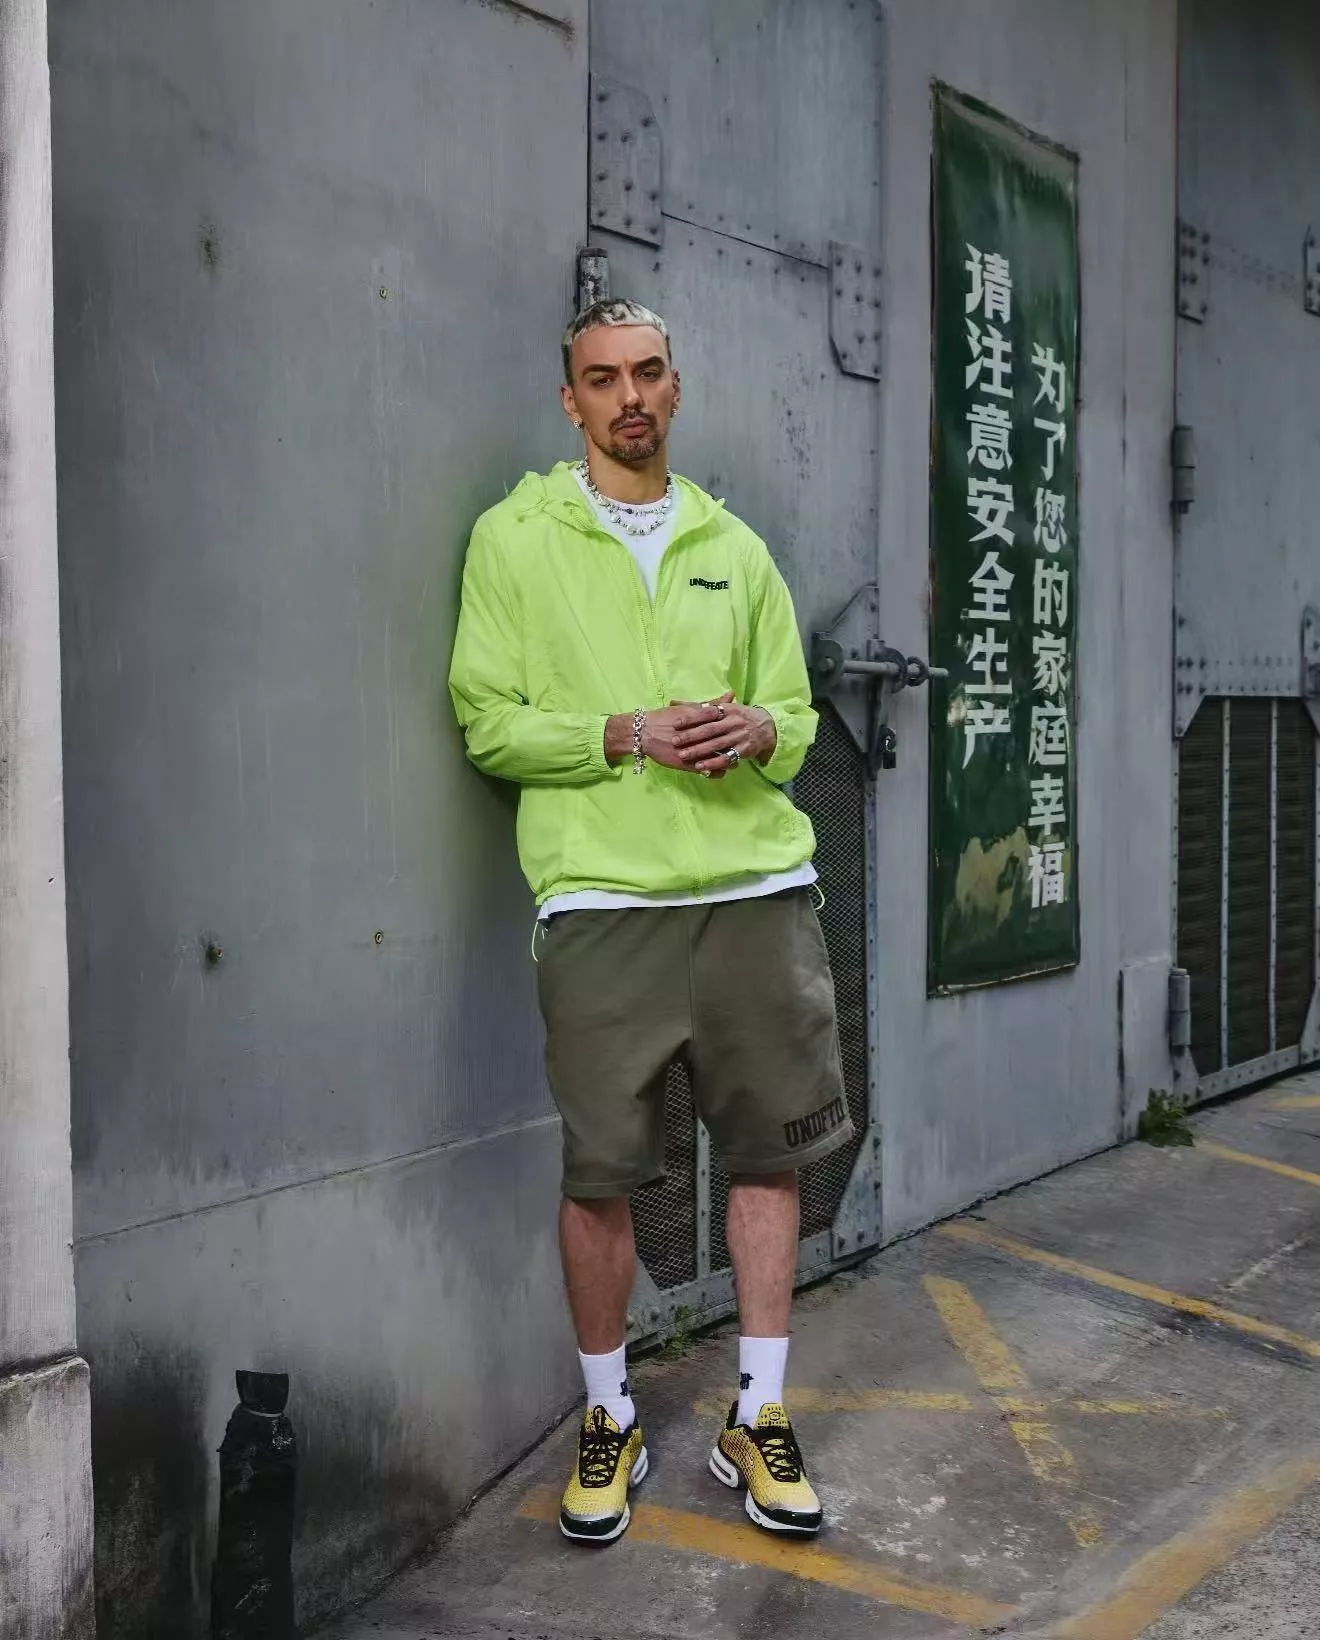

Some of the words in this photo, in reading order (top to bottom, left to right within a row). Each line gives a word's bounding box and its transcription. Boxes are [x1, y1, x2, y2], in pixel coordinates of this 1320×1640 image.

[962, 242, 1015, 770] 请注意安全生产
[1028, 342, 1069, 908] 为了您的家庭幸福
